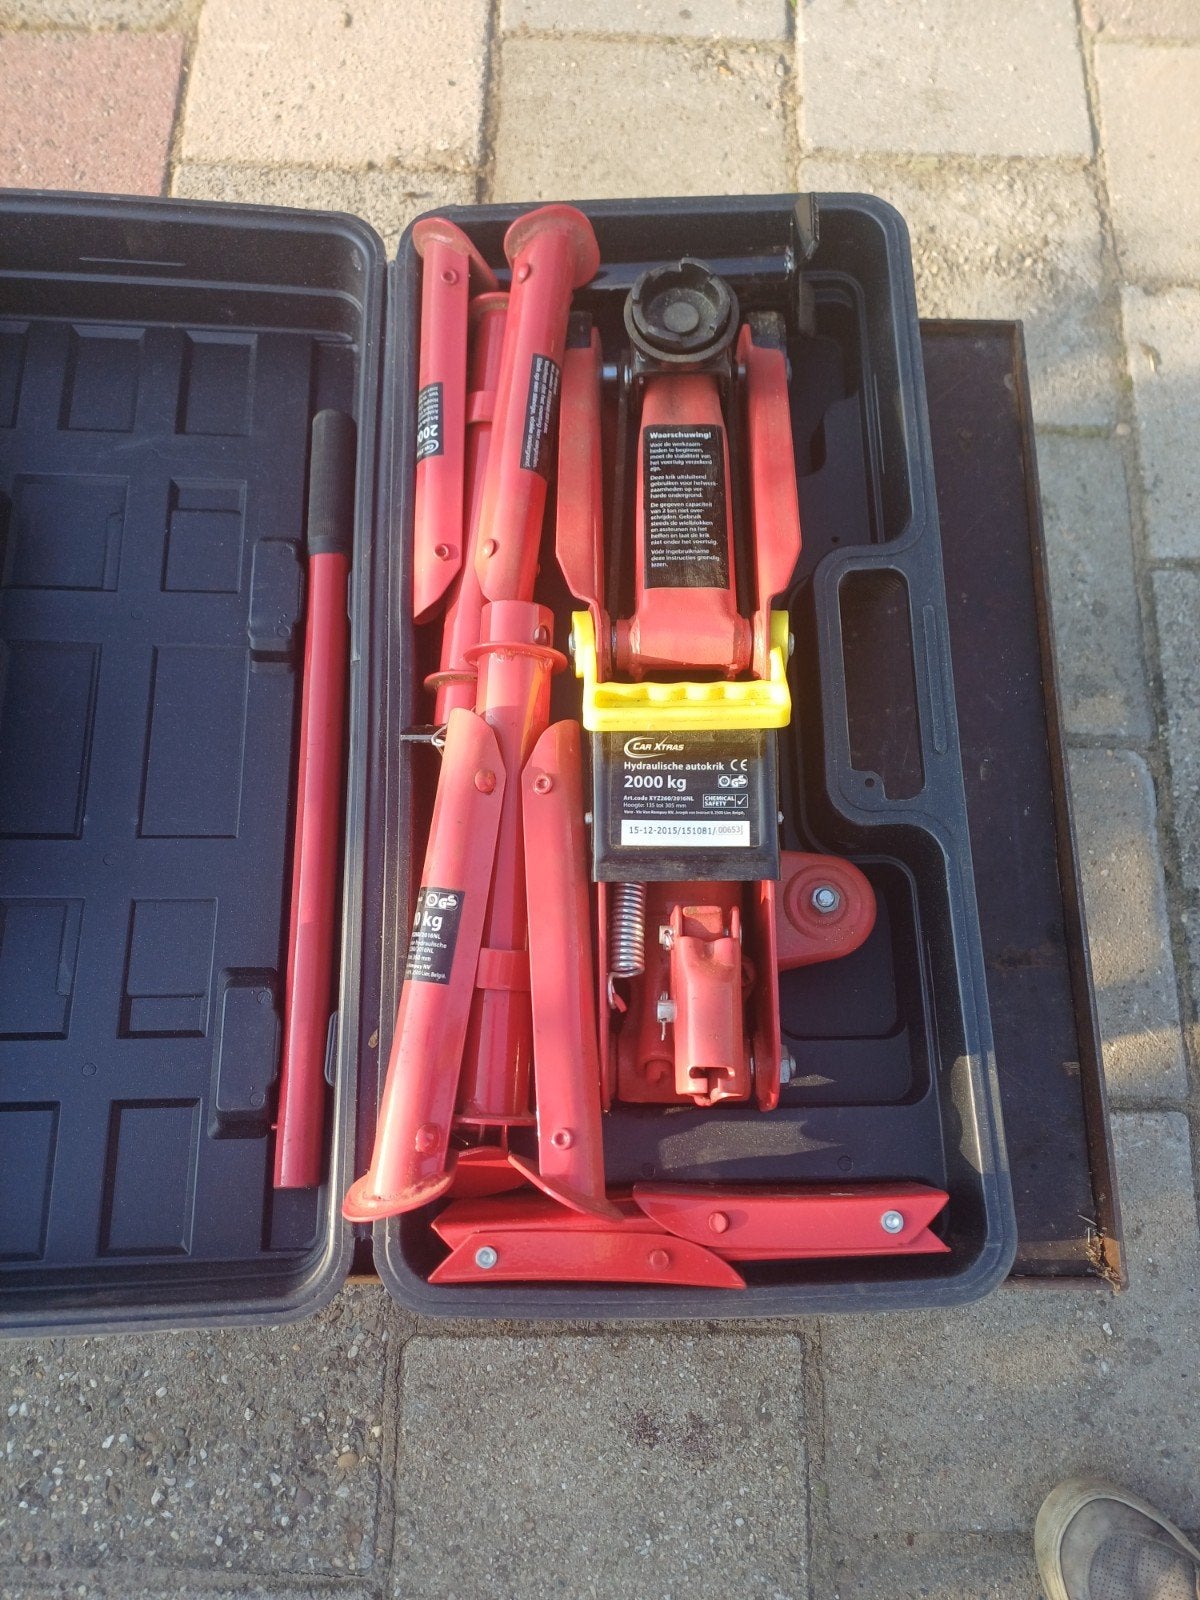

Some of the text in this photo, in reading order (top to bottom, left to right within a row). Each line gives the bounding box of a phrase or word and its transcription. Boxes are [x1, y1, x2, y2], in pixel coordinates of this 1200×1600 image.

[418, 424, 439, 443] 200
[624, 762, 684, 771] Hydraulische
[686, 762, 724, 770] autokrik
[624, 775, 686, 792] 2000 kg
[422, 911, 442, 931] kg
